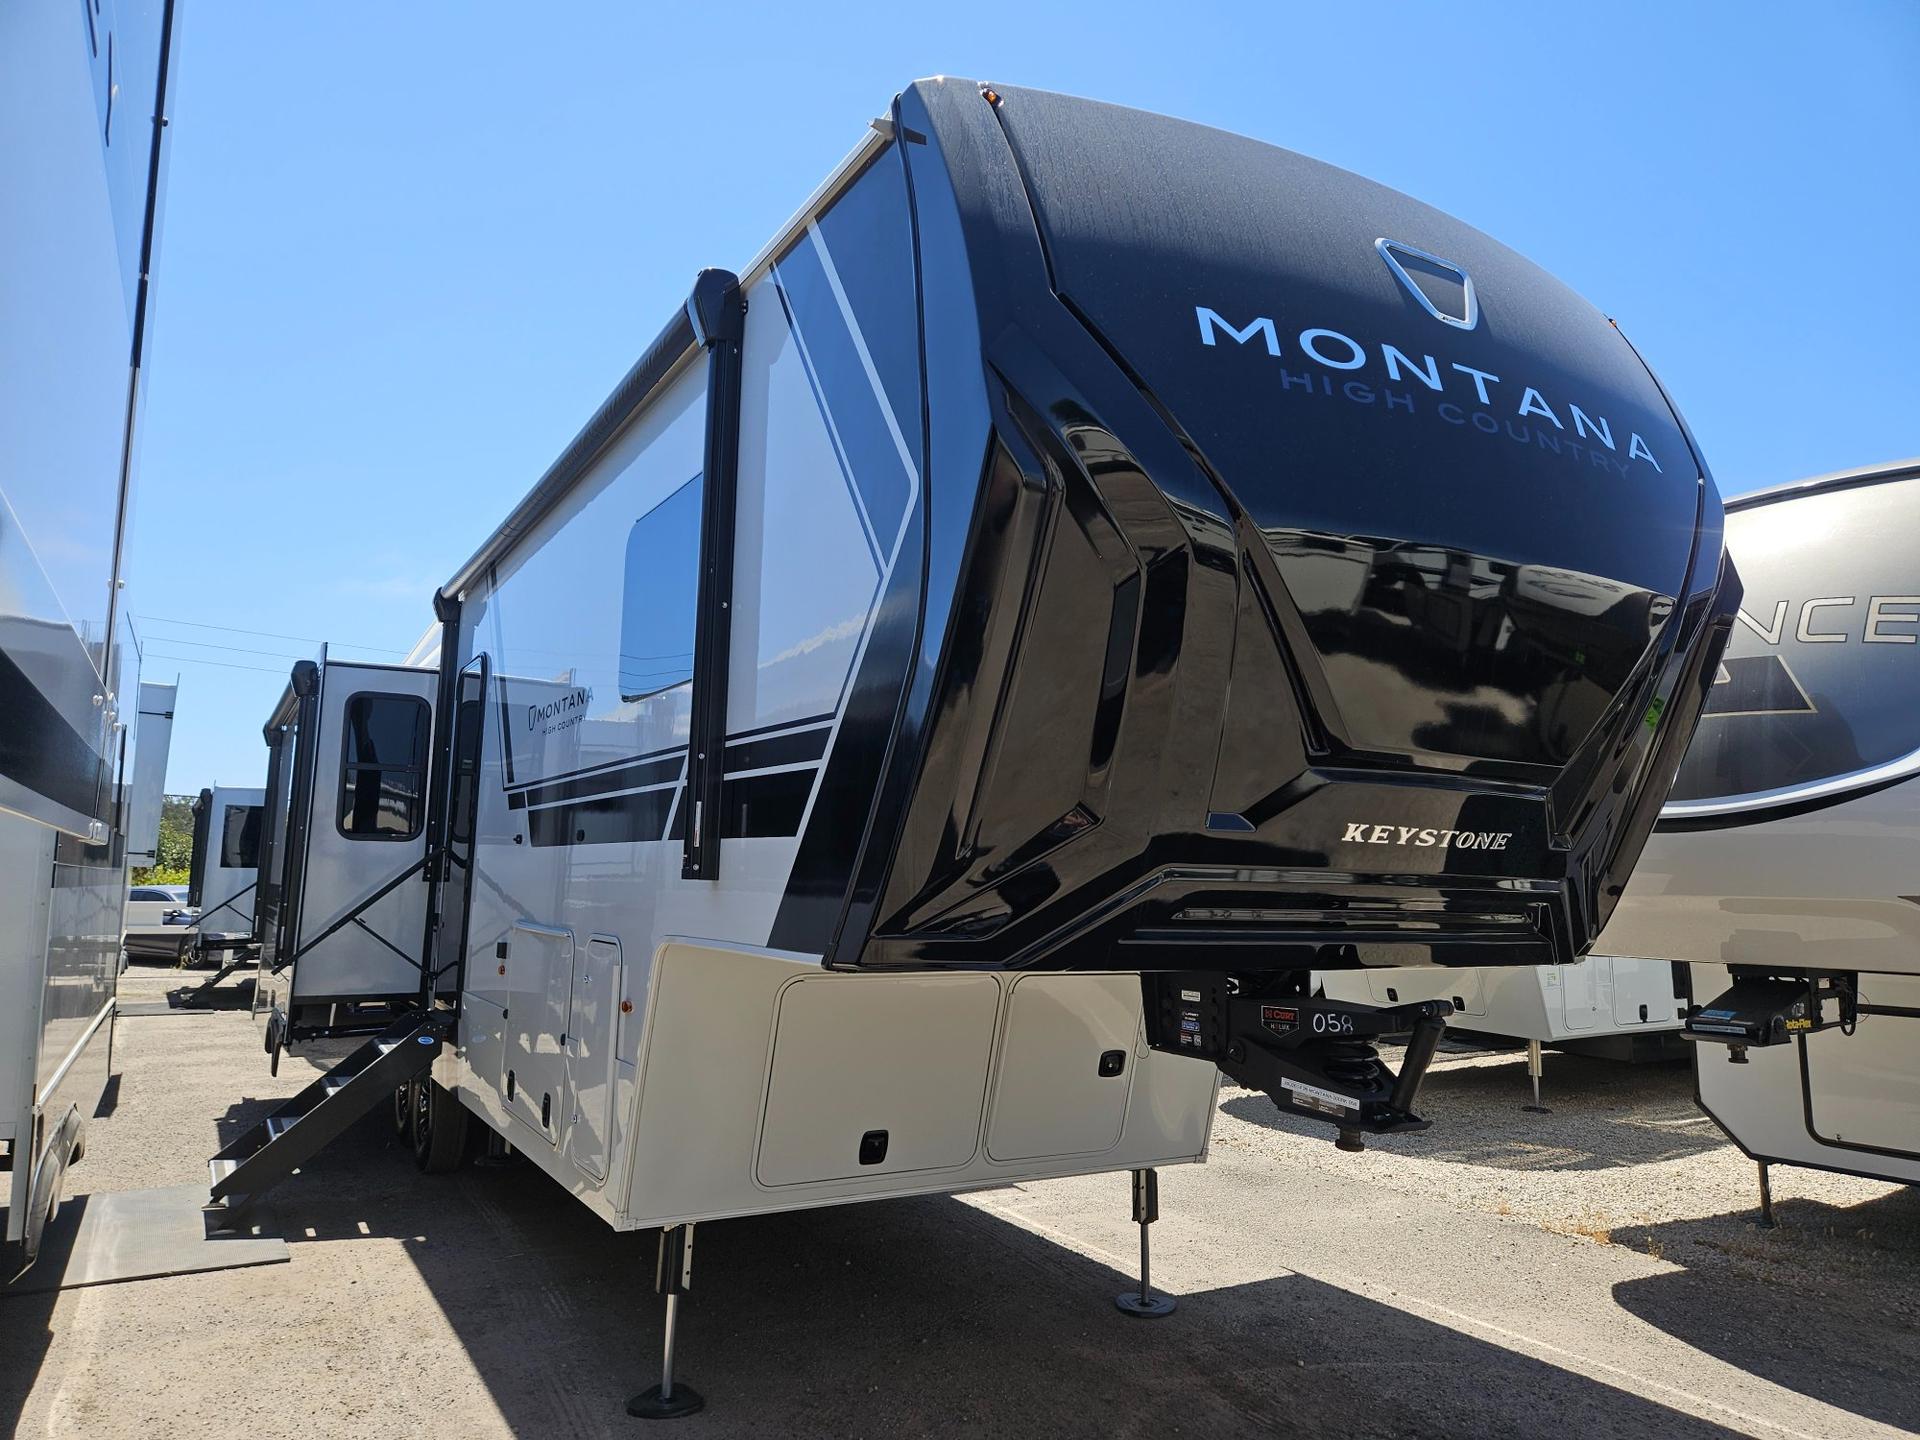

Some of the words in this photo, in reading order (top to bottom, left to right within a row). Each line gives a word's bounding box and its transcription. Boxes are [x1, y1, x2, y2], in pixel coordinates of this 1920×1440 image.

[1195, 306, 1662, 473] MONTANA
[1280, 368, 1415, 413] HIGH
[1437, 402, 1630, 480] COUNTRY
[537, 687, 593, 722] MONTANA
[557, 714, 586, 731] COUNTRY
[1341, 822, 1512, 850] KEYSTONE
[1273, 1010, 1295, 1020] CURT
[1313, 1013, 1353, 1035] 058
